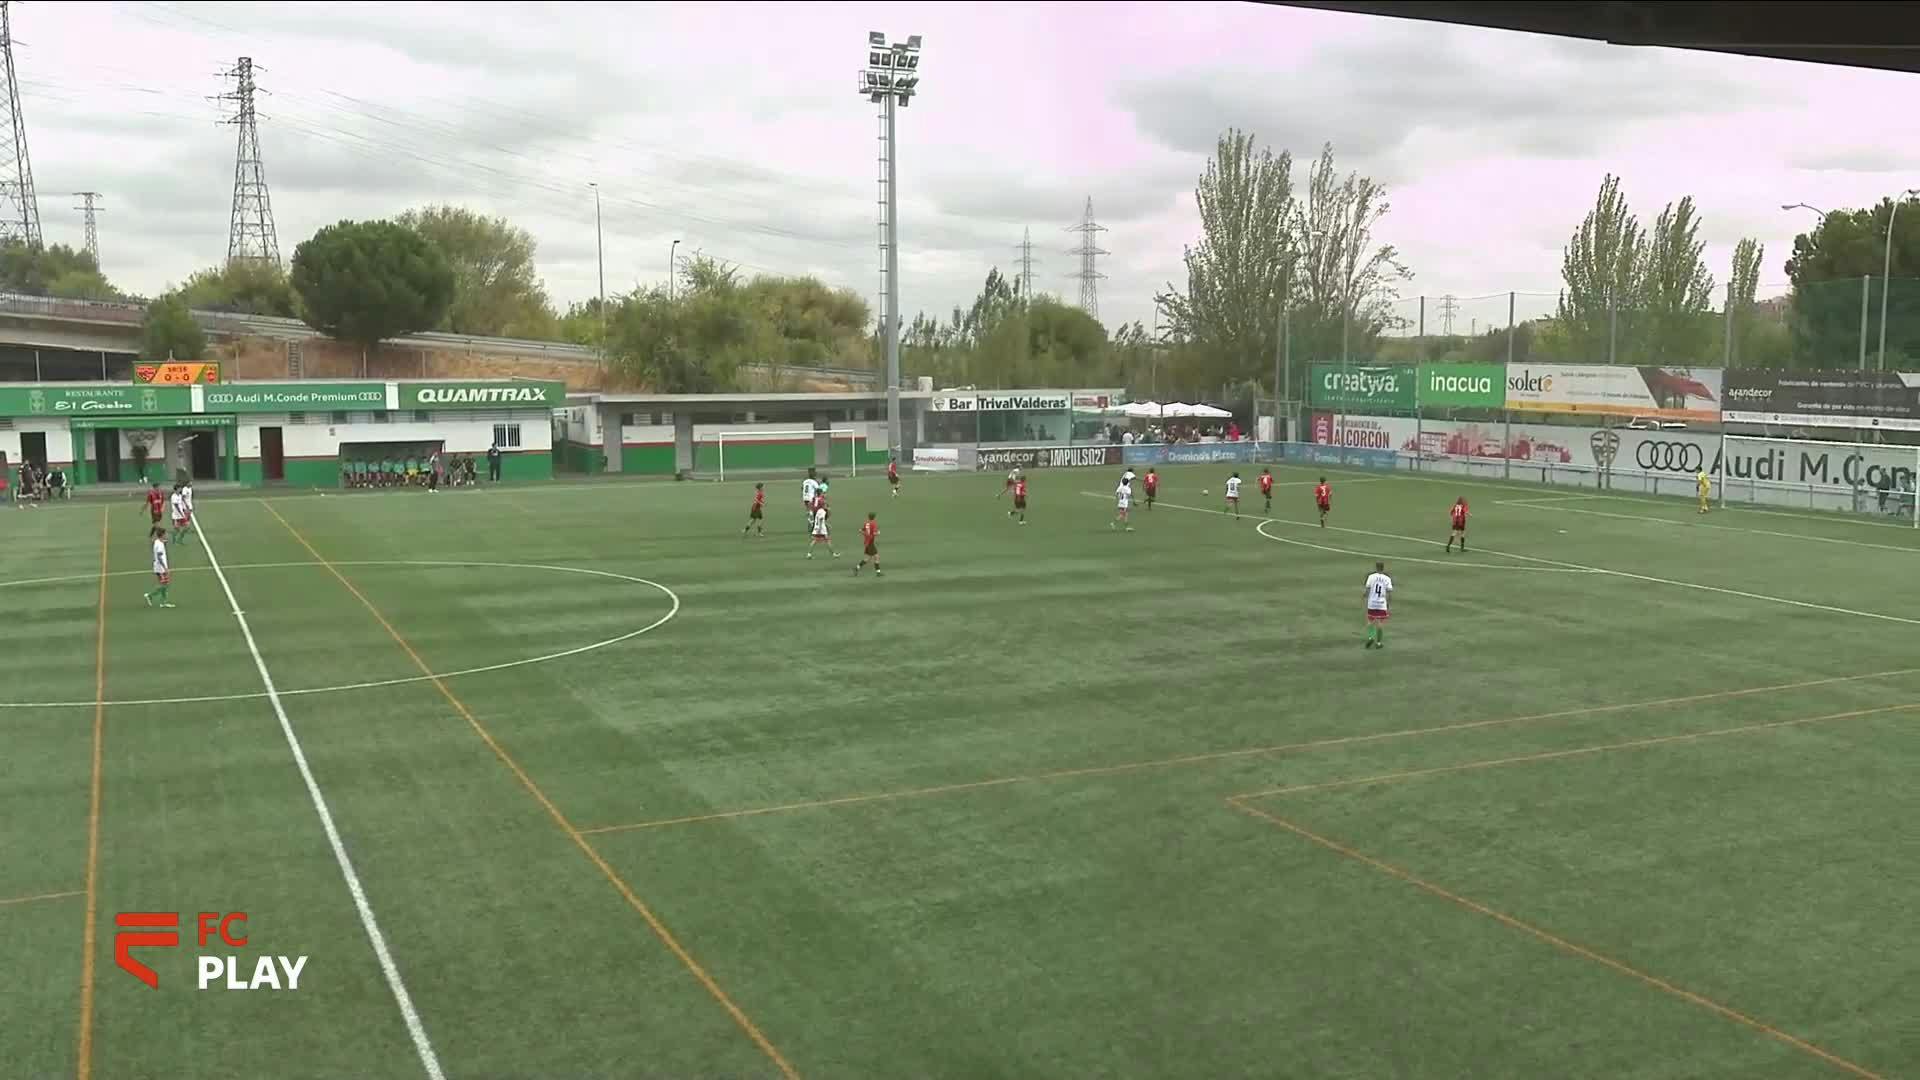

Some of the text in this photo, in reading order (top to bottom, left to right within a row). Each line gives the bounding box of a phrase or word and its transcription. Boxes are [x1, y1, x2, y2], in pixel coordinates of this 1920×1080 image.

[1431, 371, 1491, 392] inacua
[65, 389, 124, 398] RESTAURANTE
[235, 391, 358, 403] Audi M.Conde Premium
[417, 387, 547, 403] QUAMTRAX
[55, 401, 77, 411] El
[949, 398, 972, 410] Bar
[980, 397, 1066, 409] TrivalValderas
[1334, 426, 1390, 449] ACORCÓN
[1710, 447, 1785, 481] Audi
[1375, 583, 1382, 598] 4
